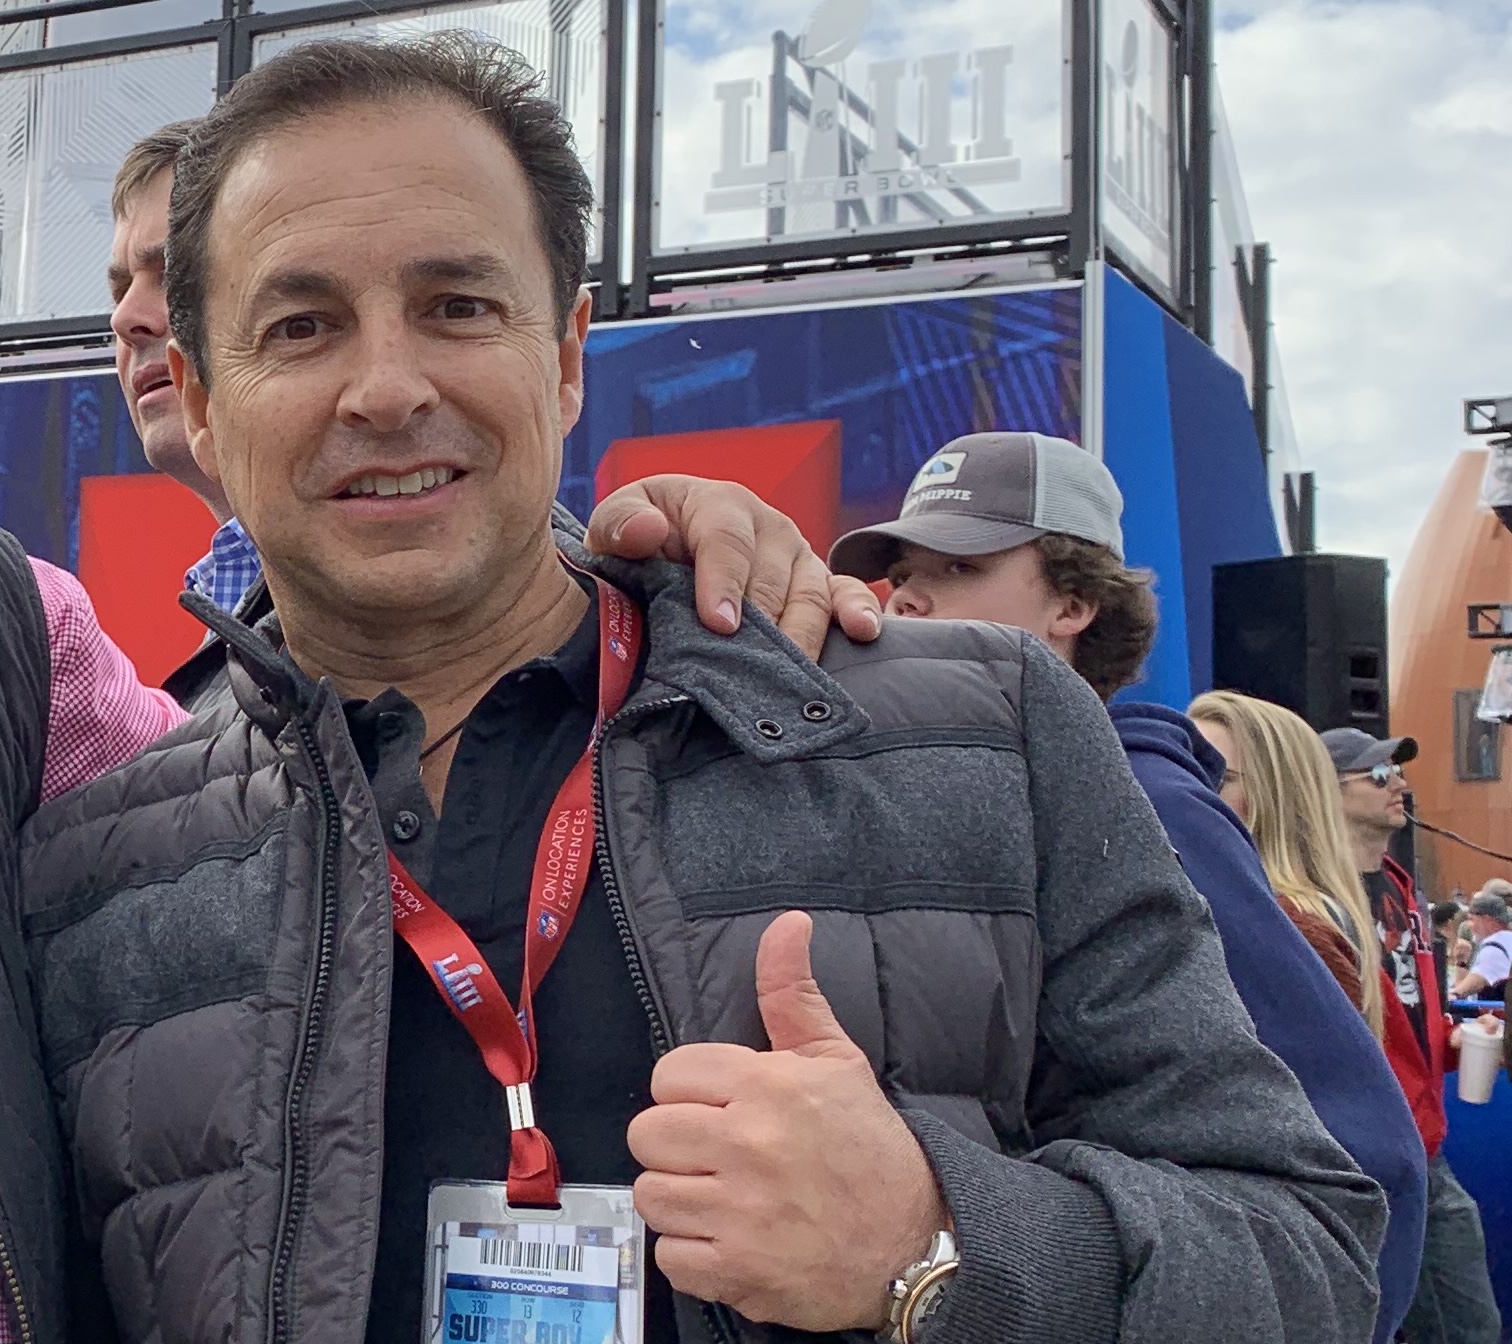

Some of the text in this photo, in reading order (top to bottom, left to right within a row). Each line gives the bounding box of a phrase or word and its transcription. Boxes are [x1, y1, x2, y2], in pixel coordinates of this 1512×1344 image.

[558, 807, 589, 910] EXPERIENCES
[490, 1280, 570, 1296] 300 CONCOURSE
[470, 1300, 581, 1324] 330 13 12
